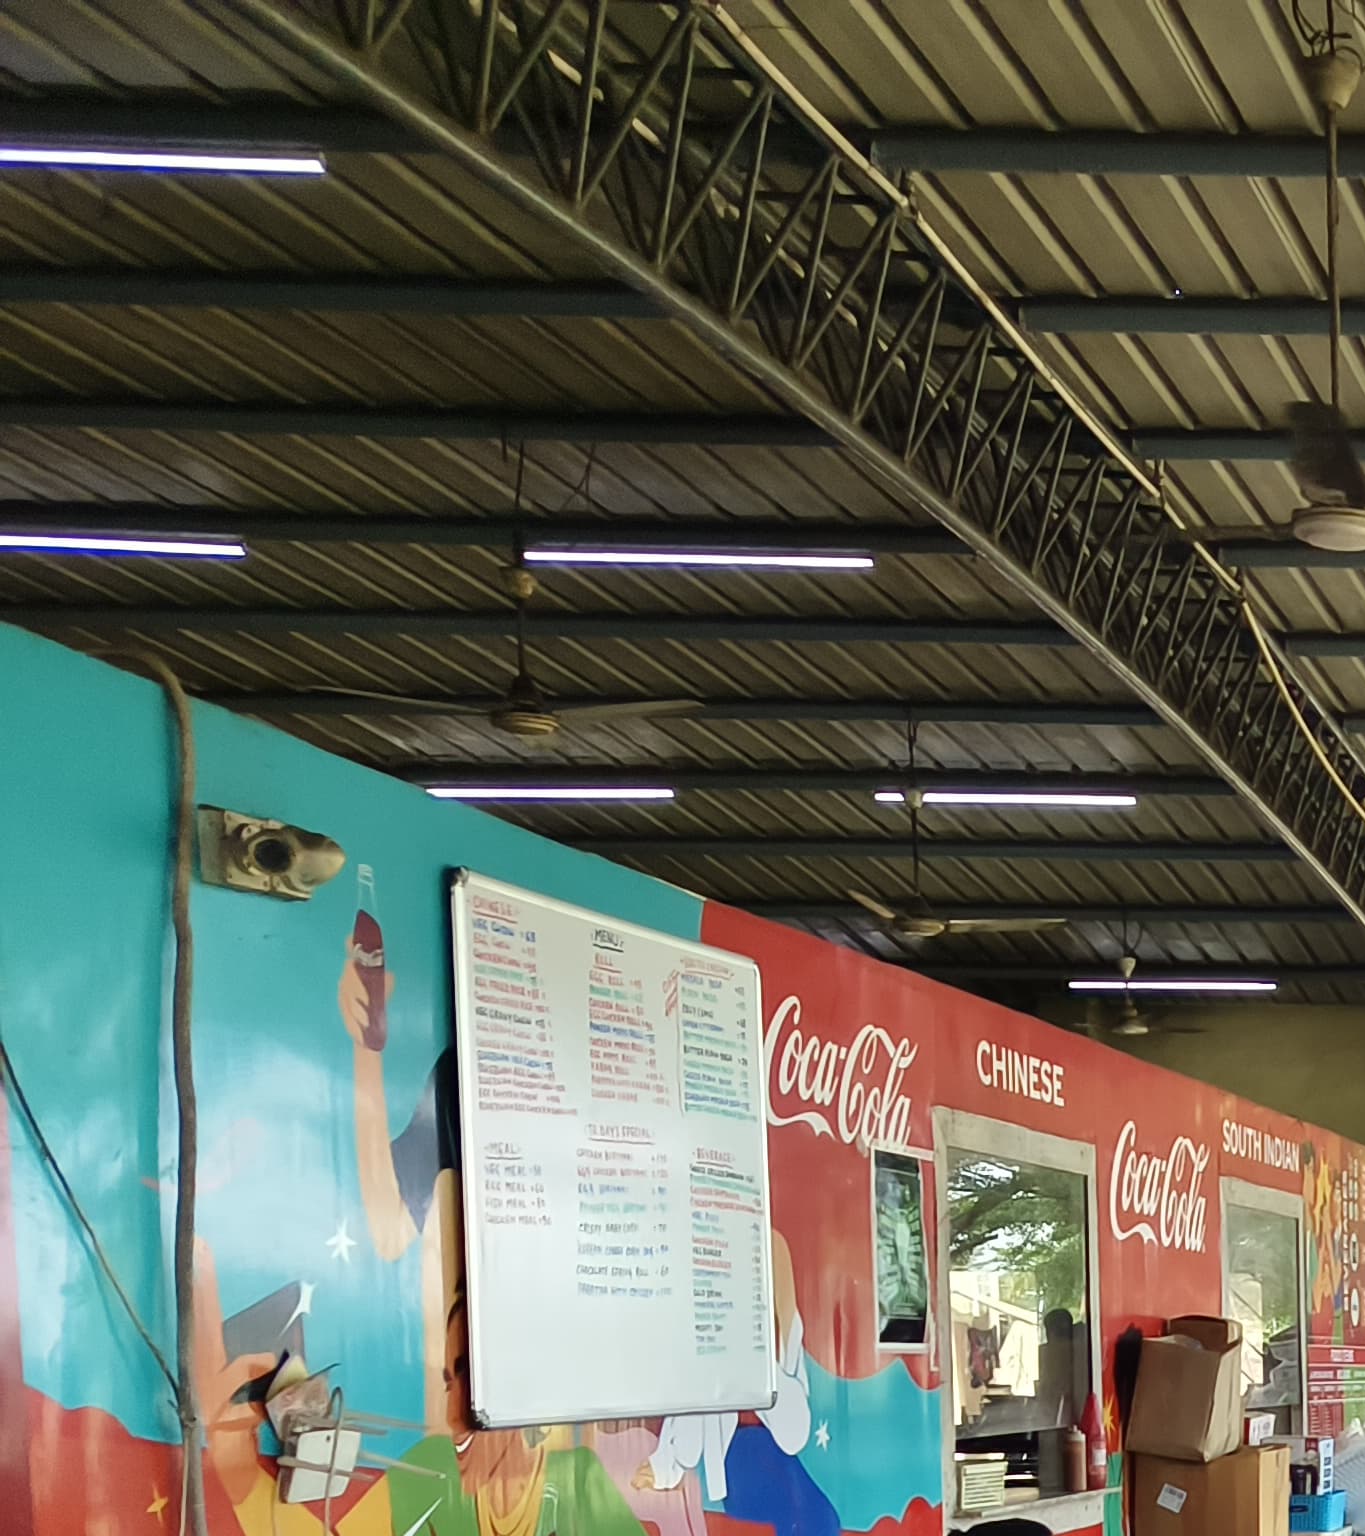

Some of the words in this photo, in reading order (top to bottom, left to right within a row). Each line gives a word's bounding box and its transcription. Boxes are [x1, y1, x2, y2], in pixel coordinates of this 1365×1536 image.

[764, 996, 918, 1146] Coca-Cola
[975, 1040, 1065, 1107] CHINESE
[1110, 1120, 1210, 1253] Coca-Cola
[1222, 1119, 1262, 1163] SOUTH
[1263, 1132, 1300, 1173] INDIAN
